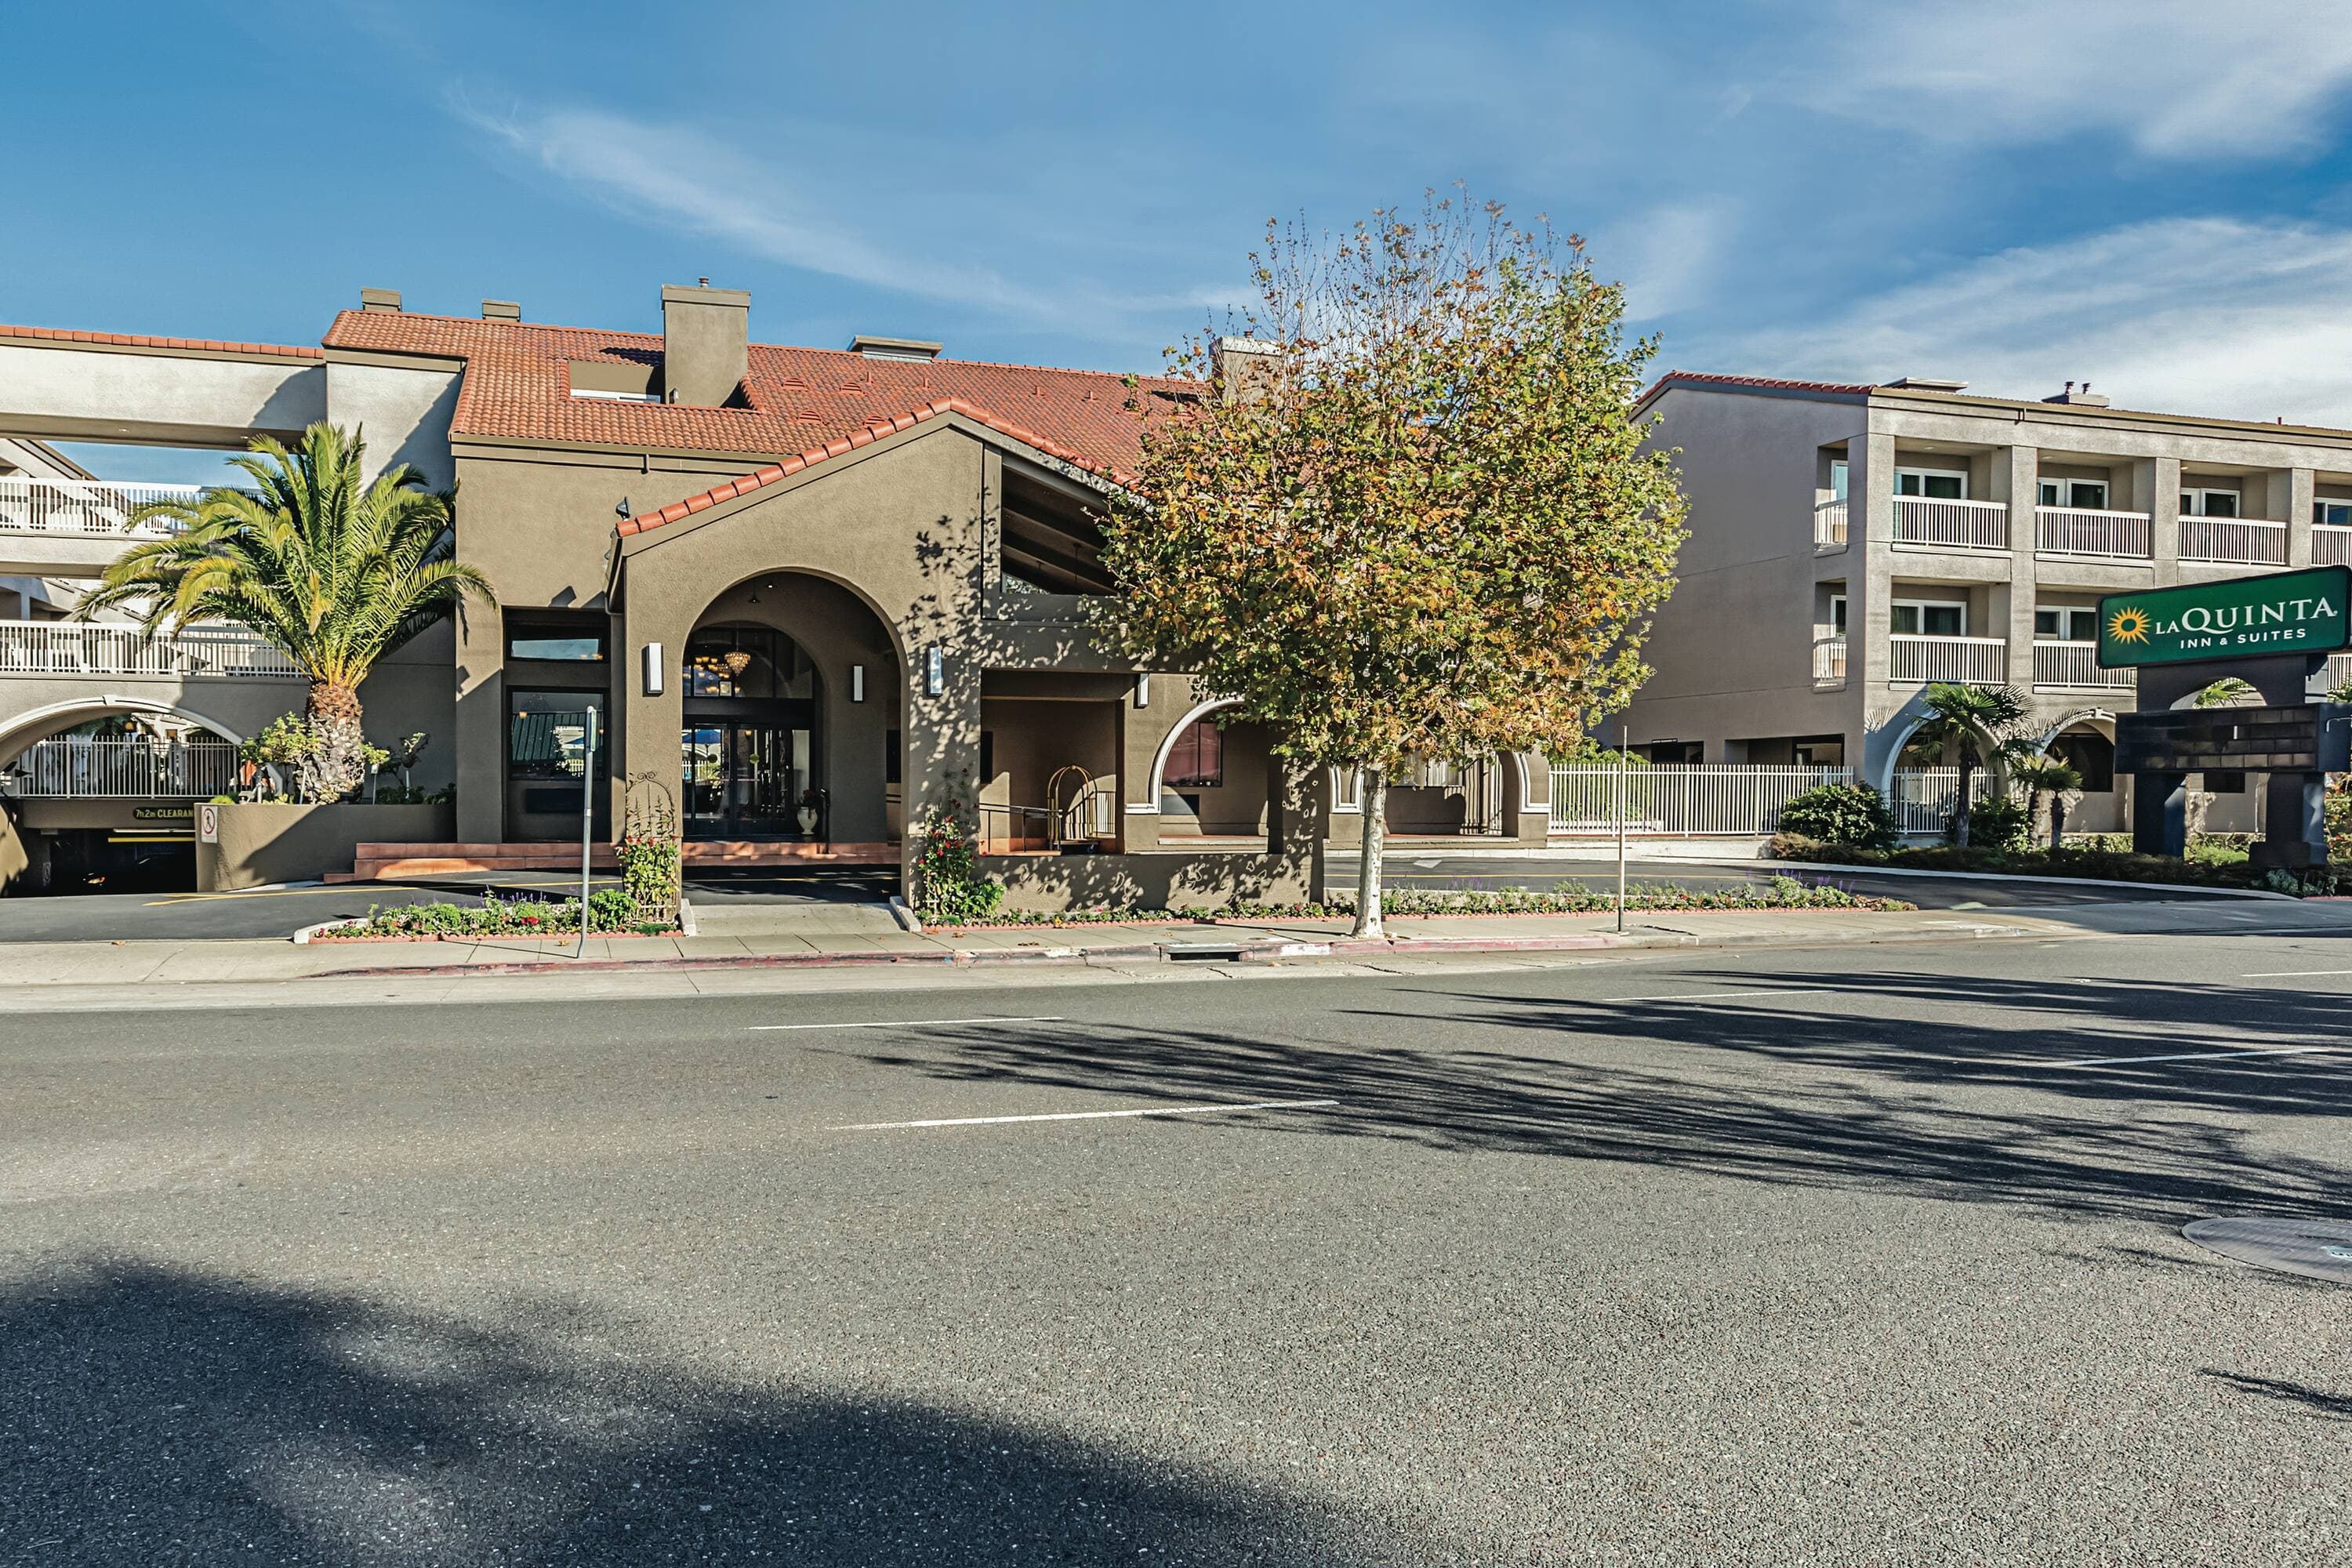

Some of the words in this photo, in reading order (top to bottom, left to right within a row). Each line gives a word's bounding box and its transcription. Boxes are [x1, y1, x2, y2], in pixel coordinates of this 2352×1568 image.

[2156, 621, 2180, 634] LA
[2181, 597, 2335, 634] QUINTA
[2180, 637, 2211, 649] INN
[2237, 628, 2306, 644] SUITES
